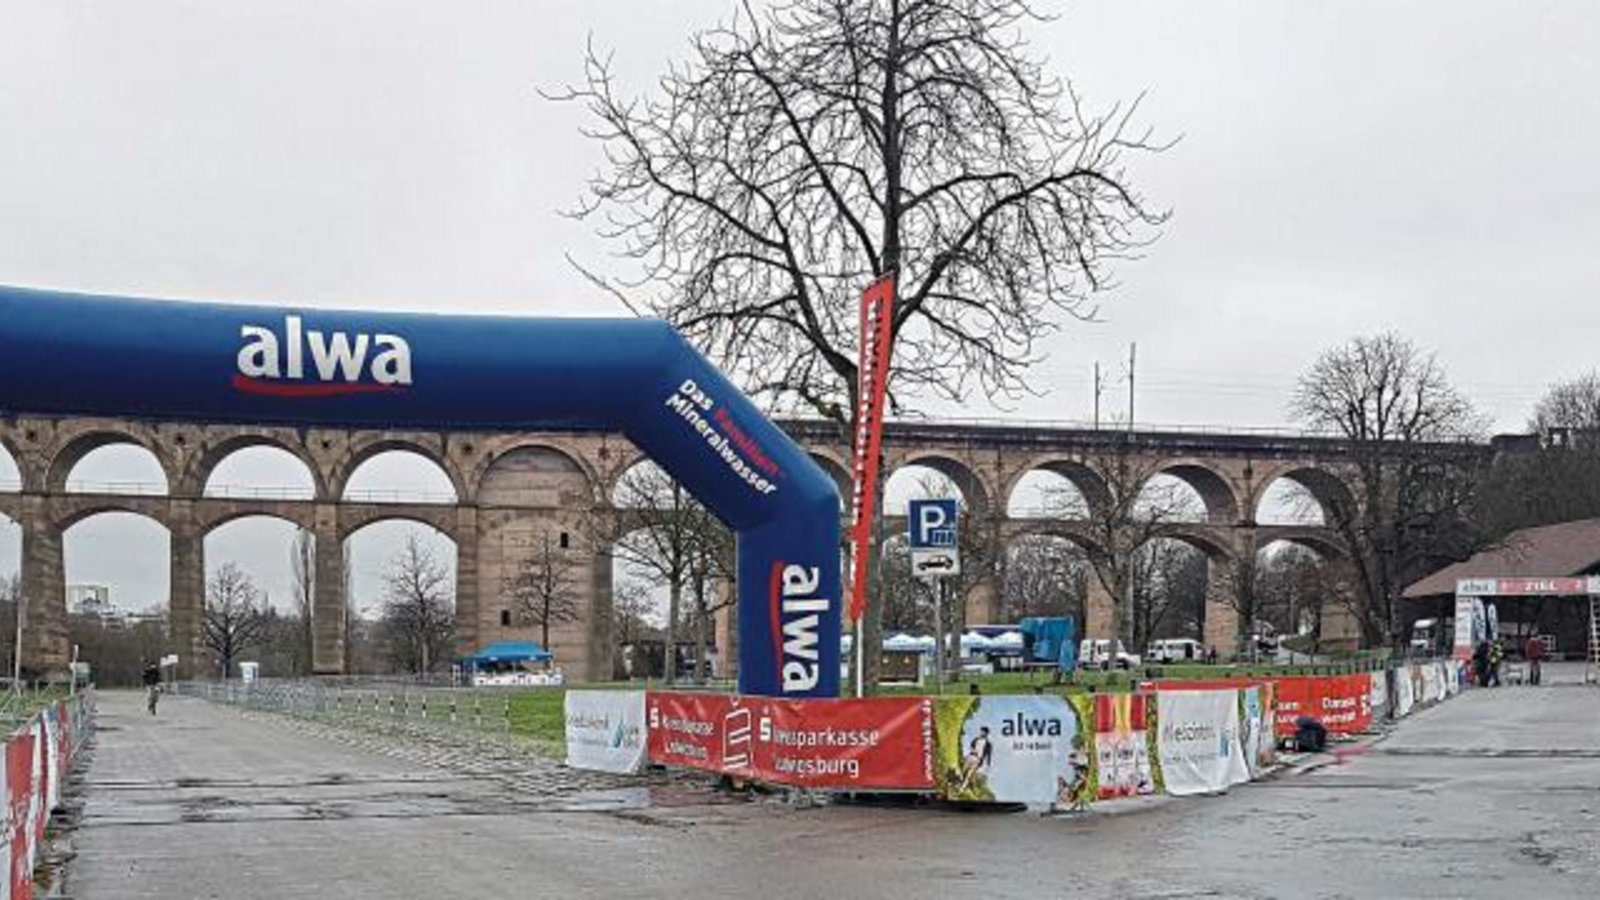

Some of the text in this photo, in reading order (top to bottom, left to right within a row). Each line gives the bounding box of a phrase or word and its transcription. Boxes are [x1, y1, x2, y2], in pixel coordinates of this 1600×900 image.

[237, 315, 412, 384] alwa
[680, 379, 714, 411] Das
[665, 393, 777, 494] Mineralwasser
[919, 505, 946, 543] P
[782, 564, 829, 693] alwa
[1001, 712, 1062, 737] alwa
